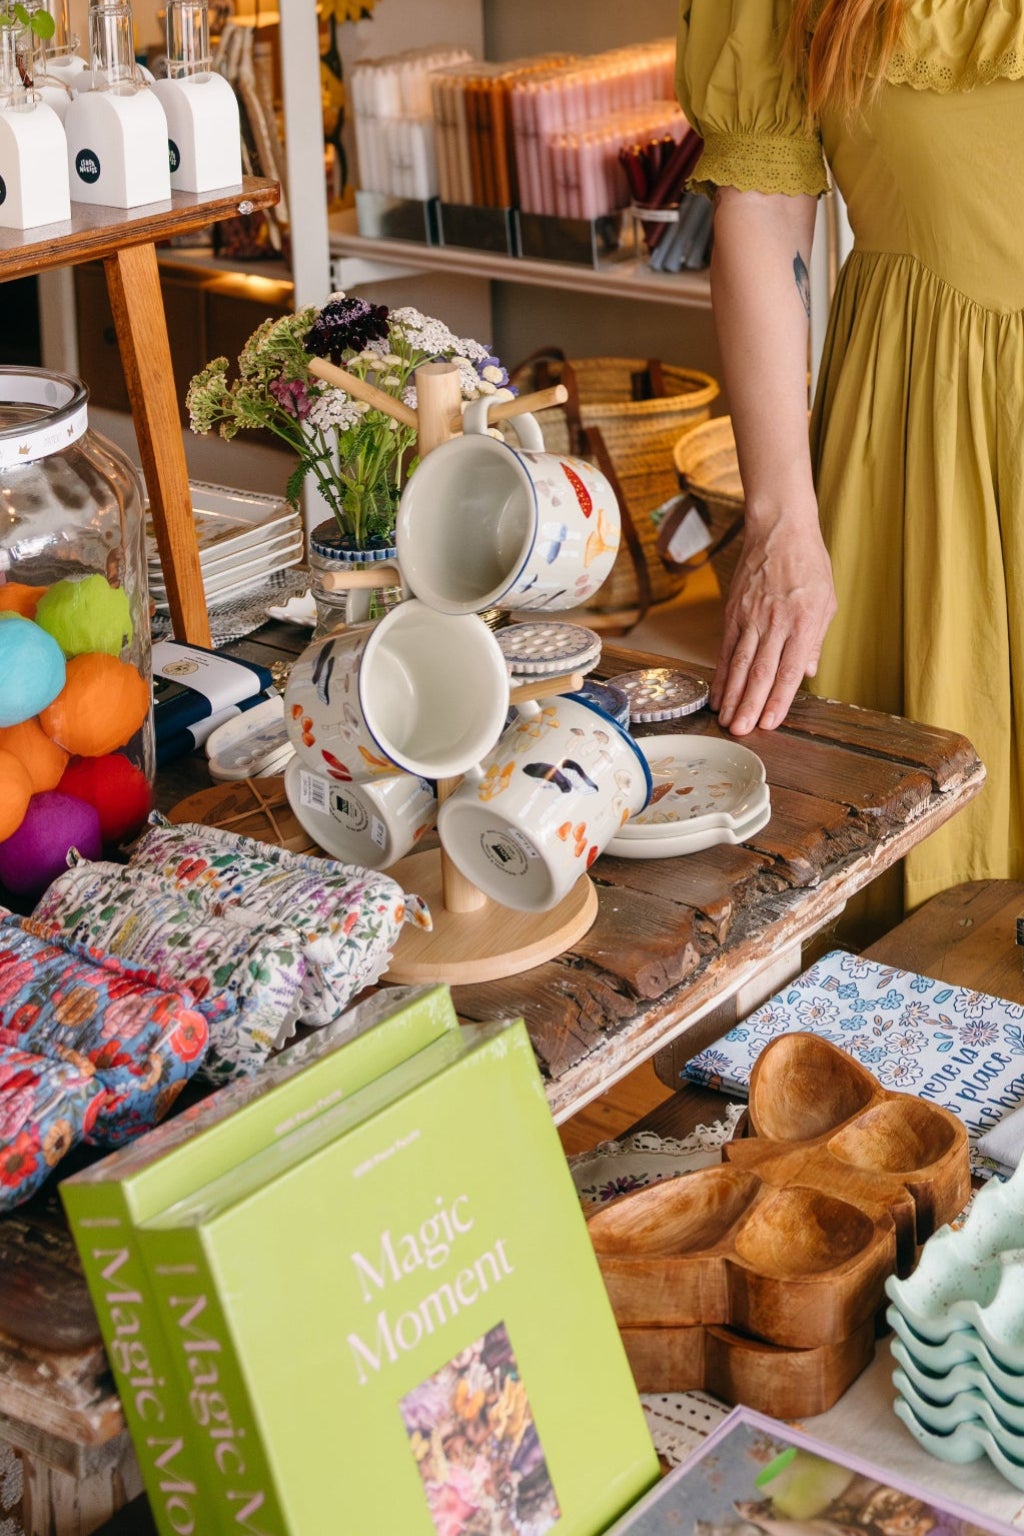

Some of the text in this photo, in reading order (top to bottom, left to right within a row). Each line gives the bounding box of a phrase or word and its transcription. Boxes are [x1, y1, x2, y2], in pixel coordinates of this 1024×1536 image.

[955, 1052, 1013, 1104] place
[346, 1238, 515, 1385] Moment
[351, 1194, 475, 1304] Magic
[92, 1247, 166, 1423] Magic
[168, 1294, 246, 1476] Magic
